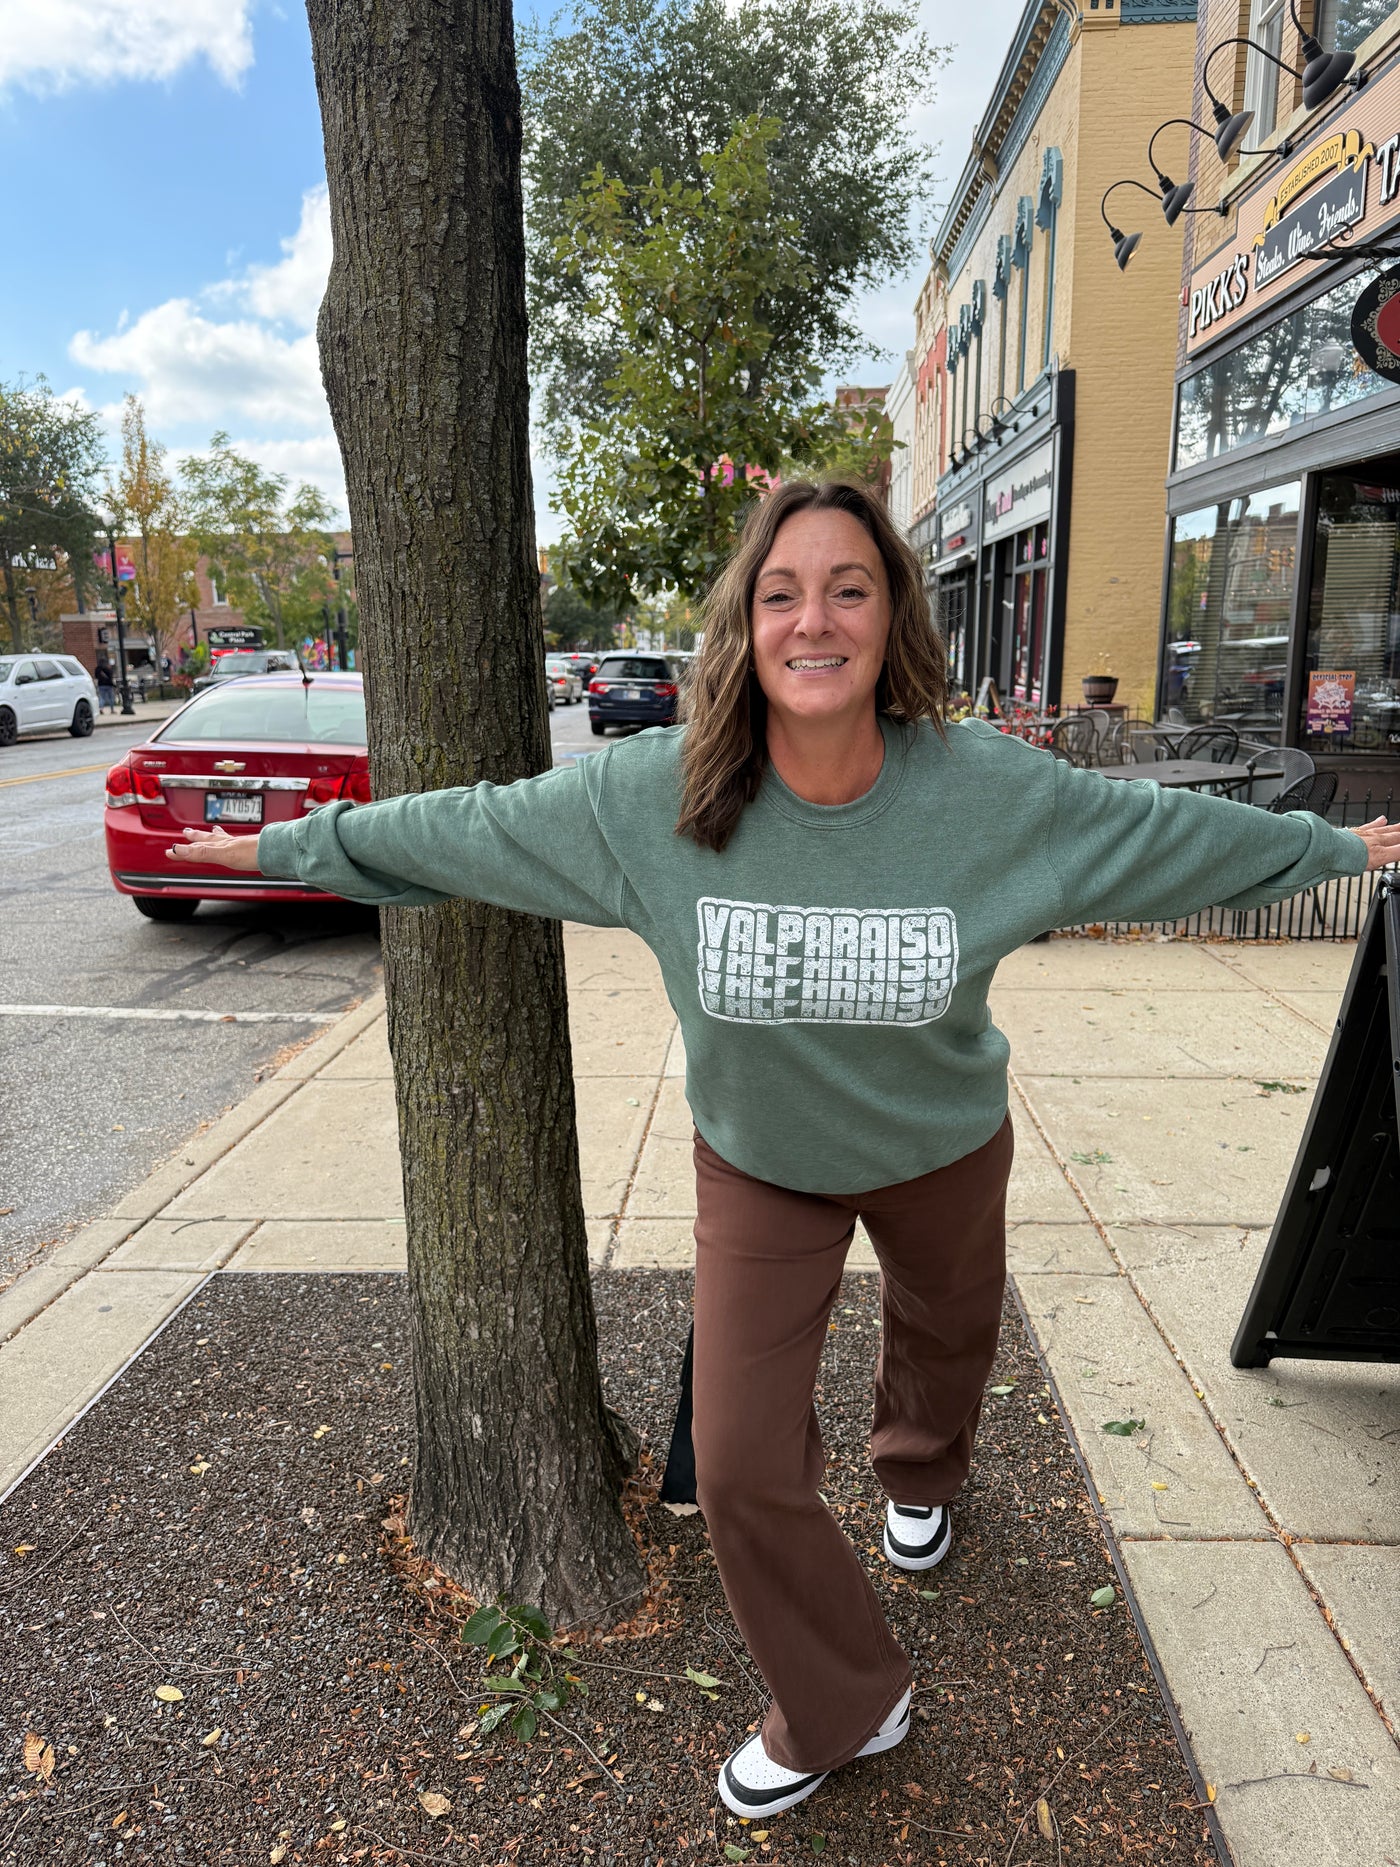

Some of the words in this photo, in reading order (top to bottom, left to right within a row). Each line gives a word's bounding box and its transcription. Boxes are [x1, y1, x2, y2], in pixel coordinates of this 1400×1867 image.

[1280, 156, 1320, 204] ESTABLISHED
[1320, 144, 1339, 166] 2007
[1257, 245, 1285, 283] Steaks.
[1287, 221, 1315, 260] Wine.
[1317, 188, 1360, 239] Friends.
[1189, 253, 1249, 338] PIKK'S
[704, 905, 951, 959] VALPARAISO
